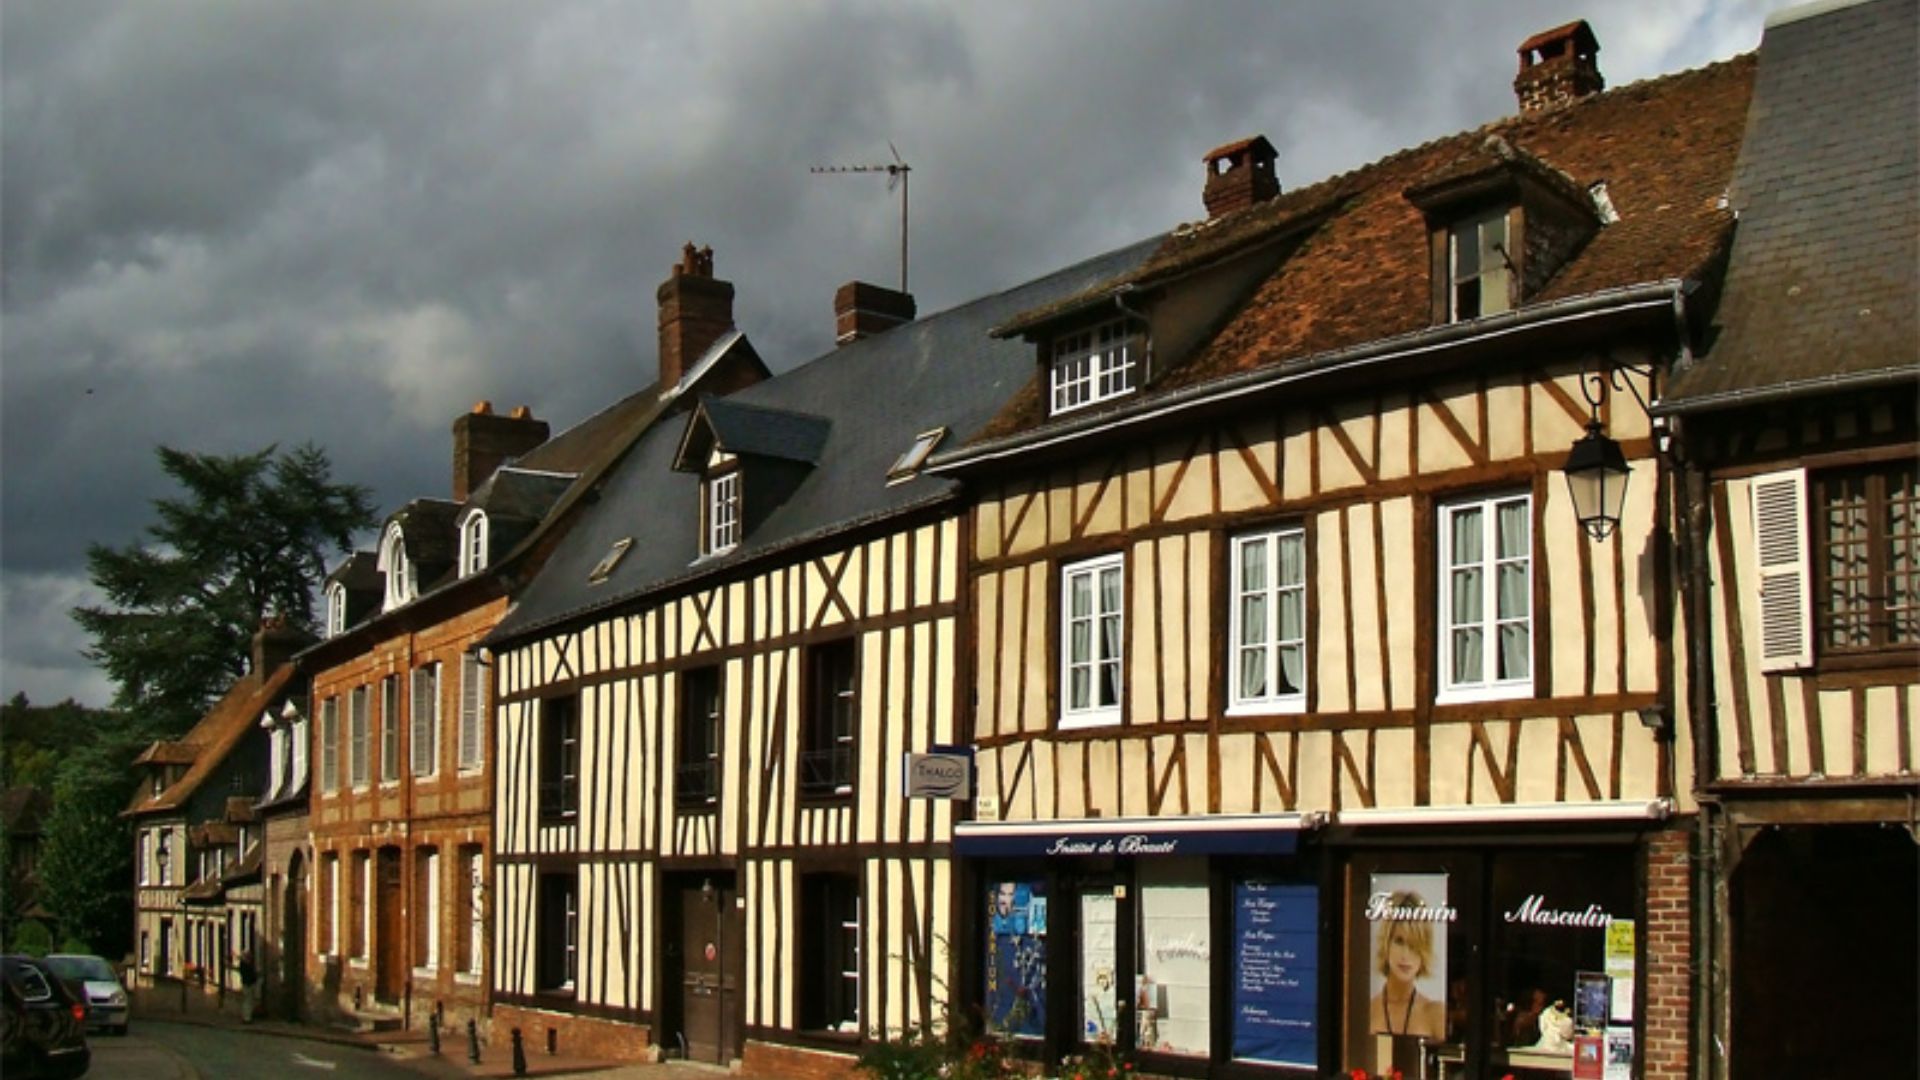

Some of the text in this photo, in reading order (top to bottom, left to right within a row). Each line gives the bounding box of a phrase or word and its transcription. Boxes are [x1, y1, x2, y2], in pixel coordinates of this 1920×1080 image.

[1046, 835, 1178, 855] Institut de Beauté
[1504, 894, 1613, 927] Masculin
